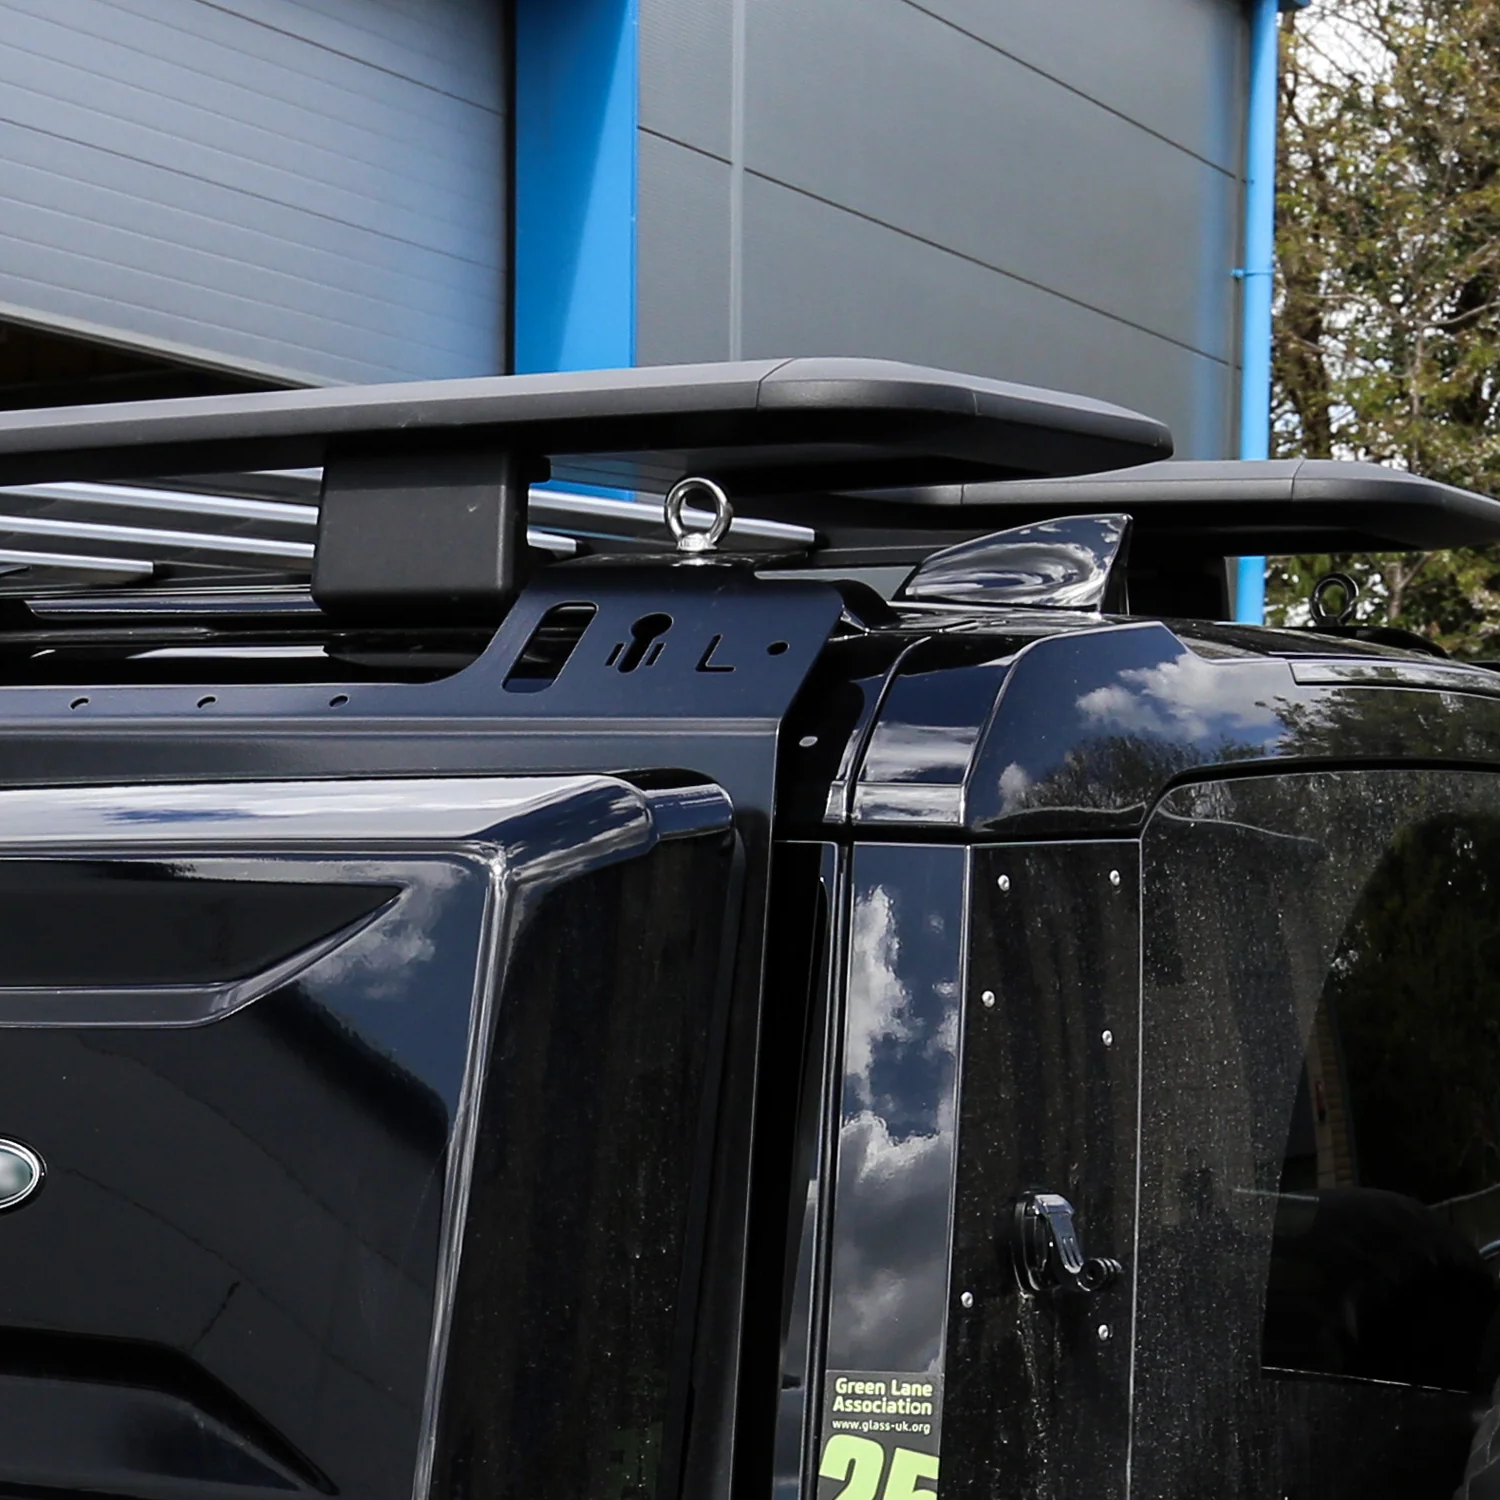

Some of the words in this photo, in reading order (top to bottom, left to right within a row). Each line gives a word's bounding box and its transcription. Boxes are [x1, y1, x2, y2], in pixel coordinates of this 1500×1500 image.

[835, 1377, 886, 1395] Green
[891, 1379, 933, 1397] Lane
[832, 1395, 933, 1416] Association
[831, 1418, 932, 1435] www.glass-uk.org
